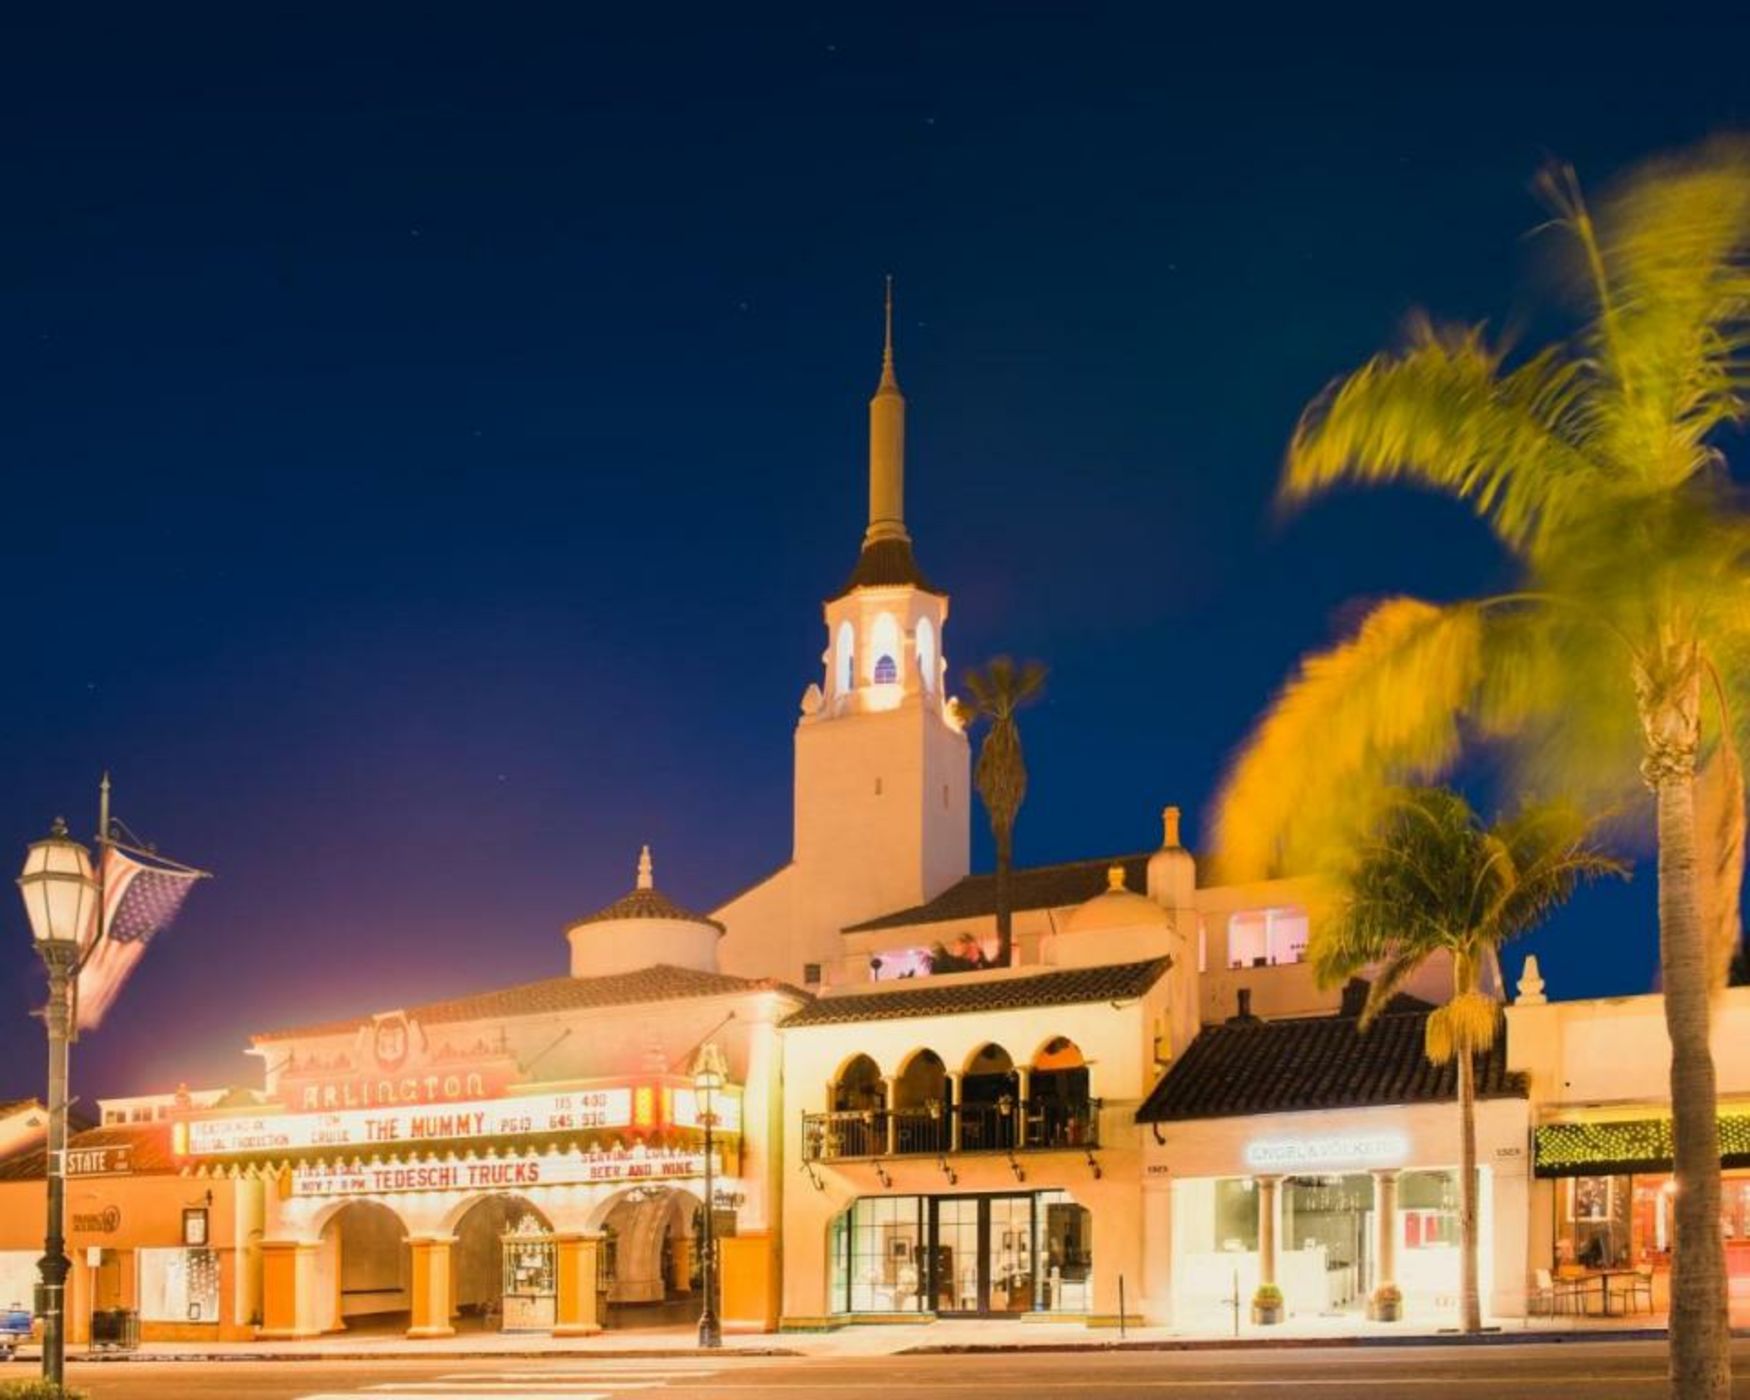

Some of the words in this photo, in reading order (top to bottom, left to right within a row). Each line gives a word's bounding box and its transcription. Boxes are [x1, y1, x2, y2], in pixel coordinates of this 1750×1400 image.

[365, 1118, 399, 1140] THE
[411, 1112, 485, 1138] MUMMY
[68, 1152, 106, 1173] STATE
[374, 1167, 459, 1189] TEDESCHI
[467, 1163, 539, 1185] TRUCKS
